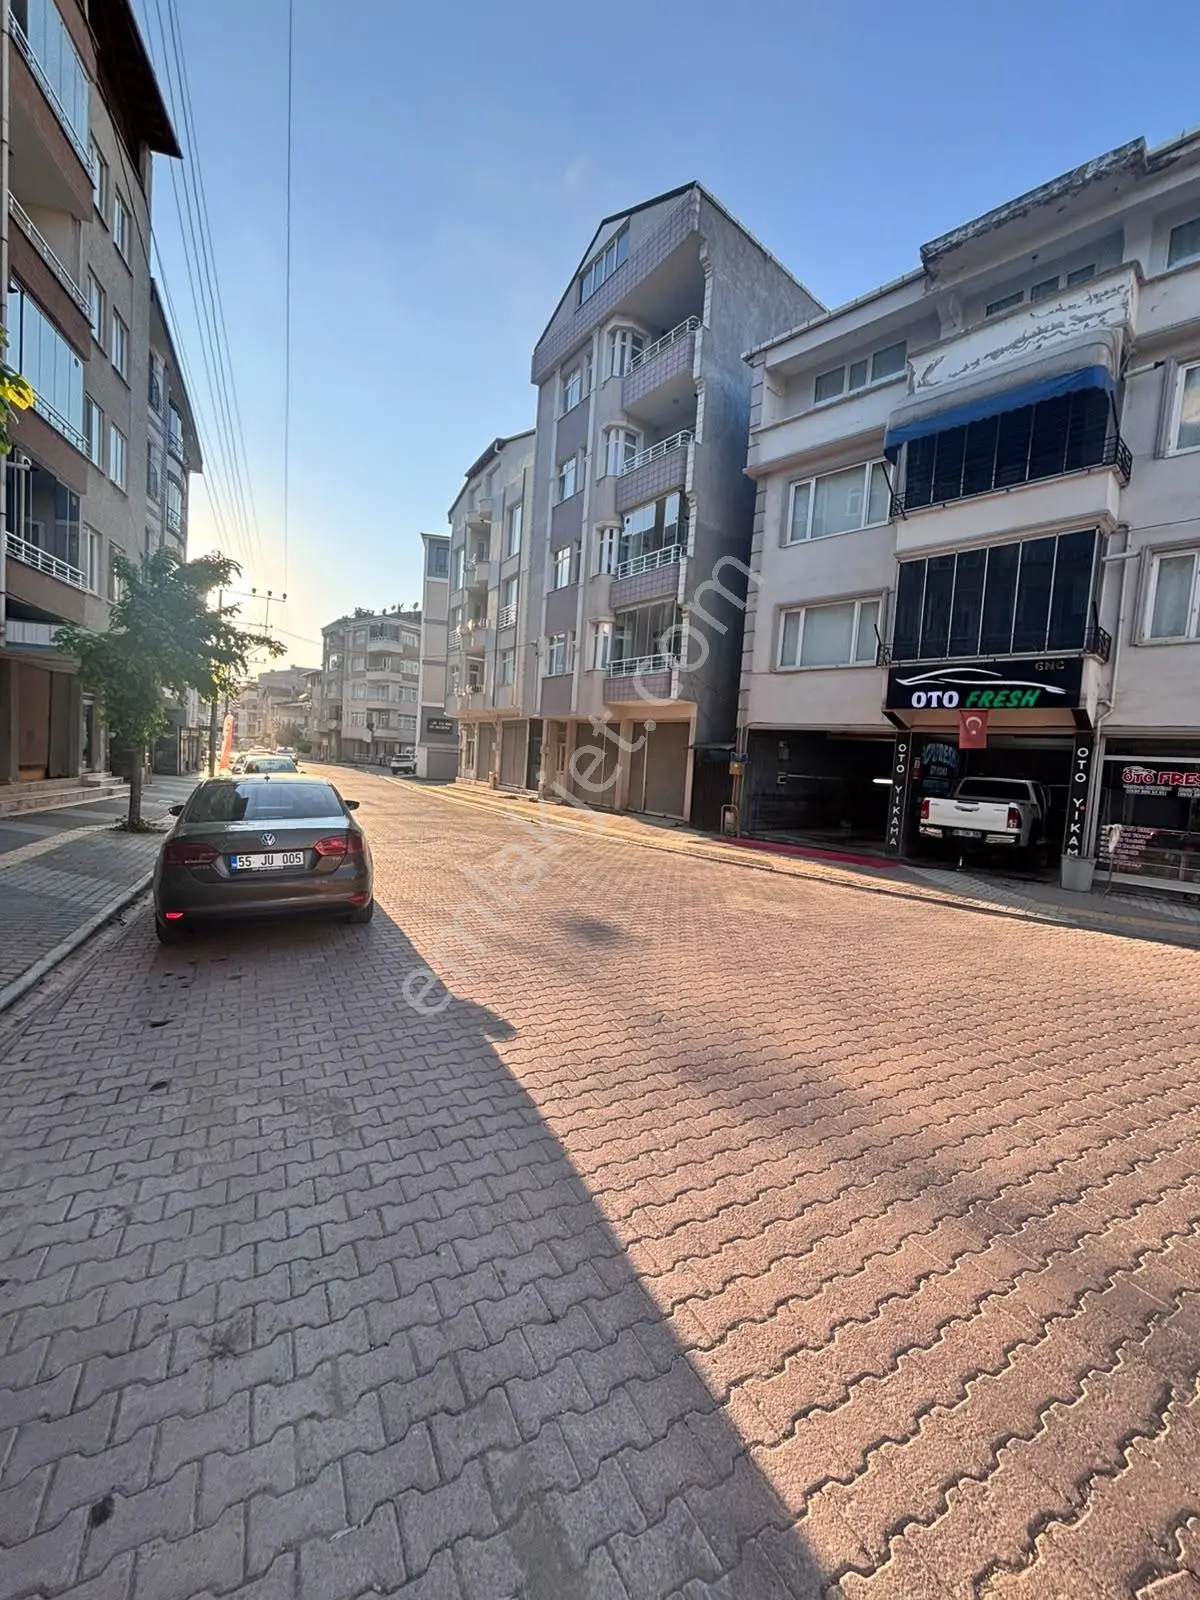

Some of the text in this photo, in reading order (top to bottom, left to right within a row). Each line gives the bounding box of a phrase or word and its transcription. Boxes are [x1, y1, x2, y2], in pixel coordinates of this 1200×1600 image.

[911, 689, 1042, 708] OTO FRESH
[1122, 771, 1155, 784] OTO
[889, 744, 907, 846] OTO YIKAMA
[1066, 747, 1089, 856] OTO YIKAM
[238, 852, 302, 867] 55 JU 005
